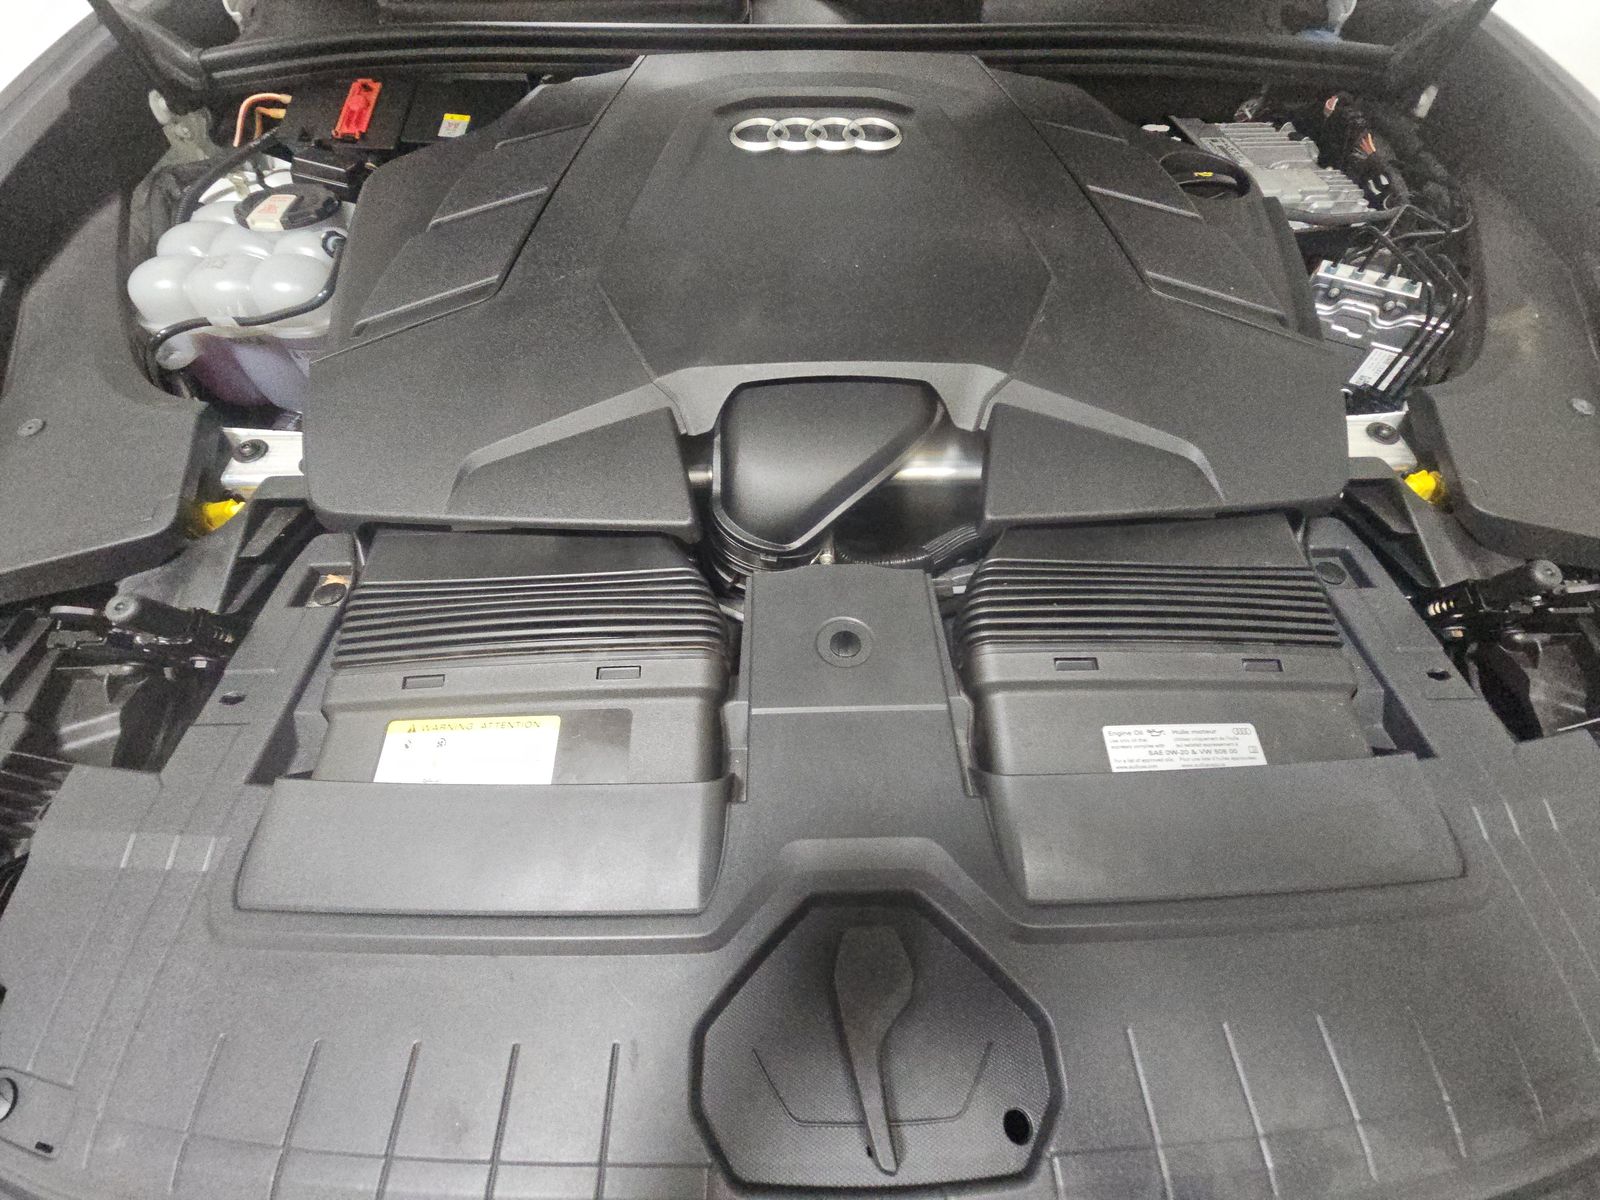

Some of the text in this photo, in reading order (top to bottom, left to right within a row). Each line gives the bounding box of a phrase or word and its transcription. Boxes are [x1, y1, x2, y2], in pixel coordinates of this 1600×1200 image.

[421, 720, 541, 733] WARNING ATTENTION
[1165, 748, 1190, 756] 0W-20
